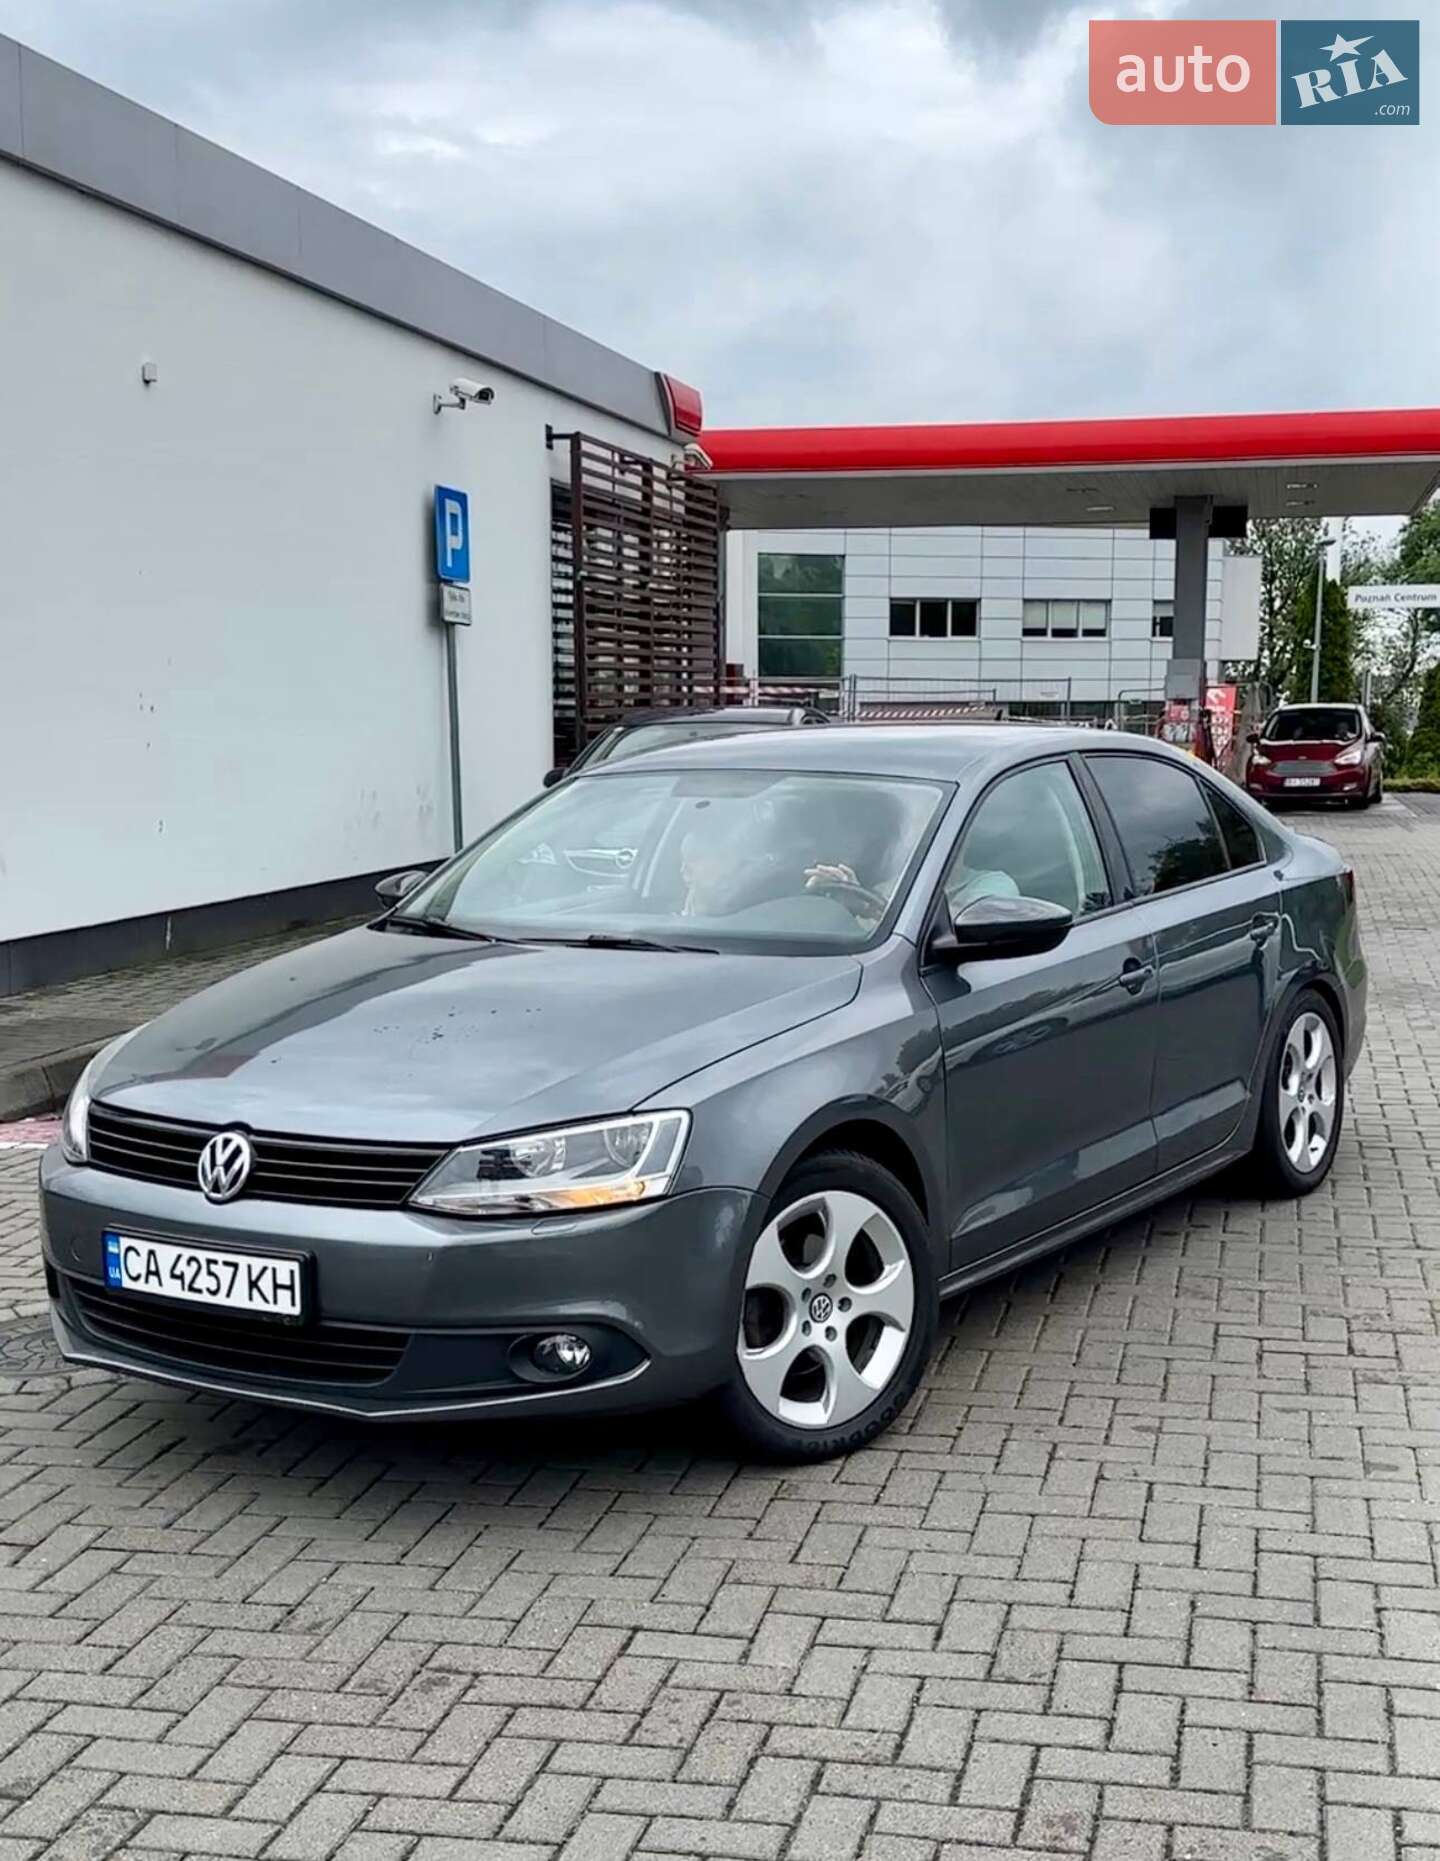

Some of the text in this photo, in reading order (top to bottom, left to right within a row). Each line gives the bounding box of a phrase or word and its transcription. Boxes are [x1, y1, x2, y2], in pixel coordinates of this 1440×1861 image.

[445, 499, 463, 568] P
[1394, 592, 1437, 602] Centrum
[108, 1265, 121, 1280] UA
[123, 1245, 297, 1308] CA 4257 KH
